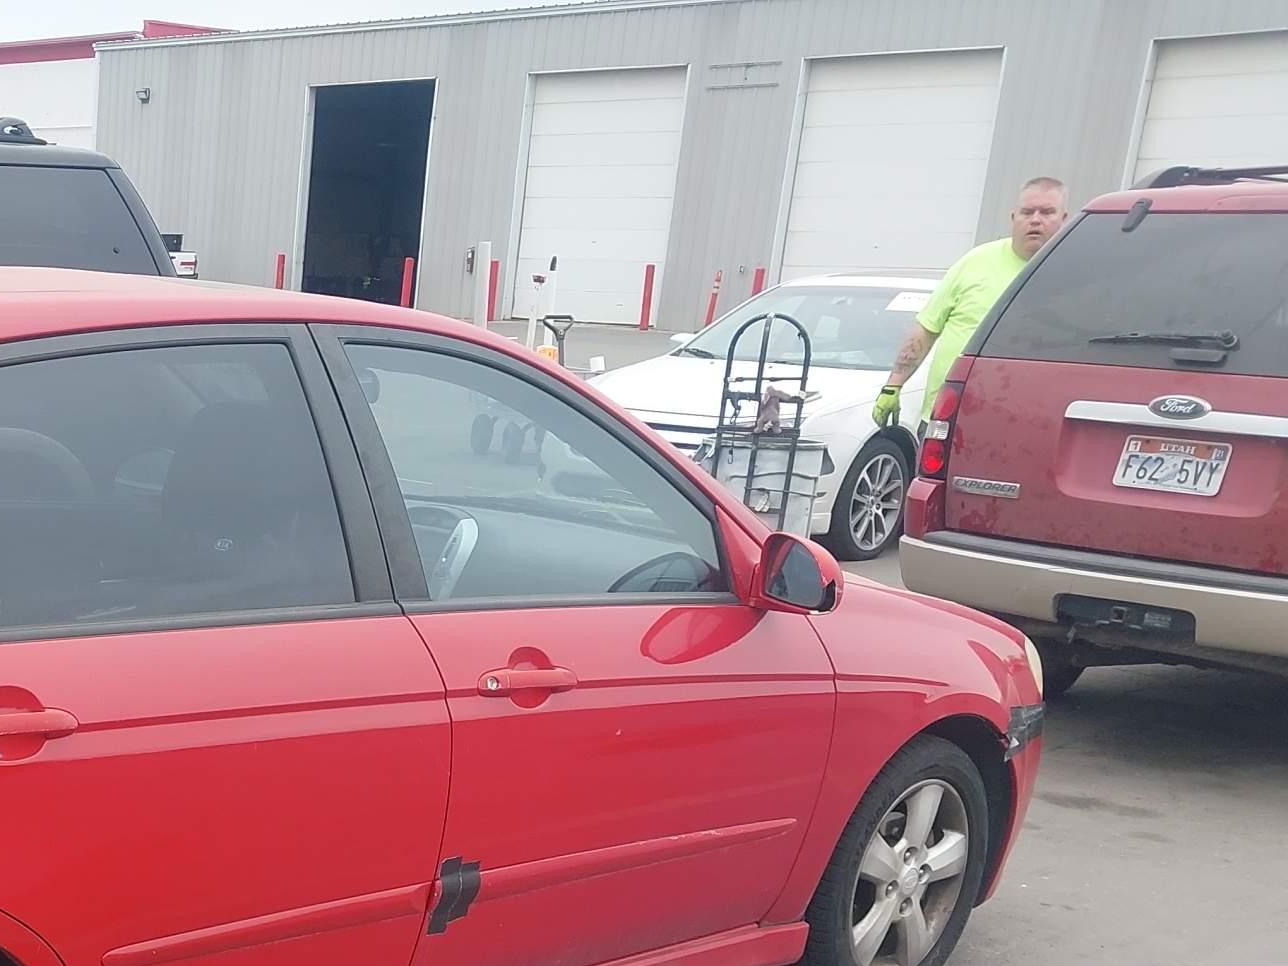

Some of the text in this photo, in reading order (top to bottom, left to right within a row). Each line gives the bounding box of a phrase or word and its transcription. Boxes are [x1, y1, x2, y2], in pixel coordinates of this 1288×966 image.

[1159, 398, 1197, 414] Ford
[1159, 442, 1197, 455] UTAH
[1121, 454, 1221, 488] F62 5VY
[954, 478, 1018, 494] EXPLORER
